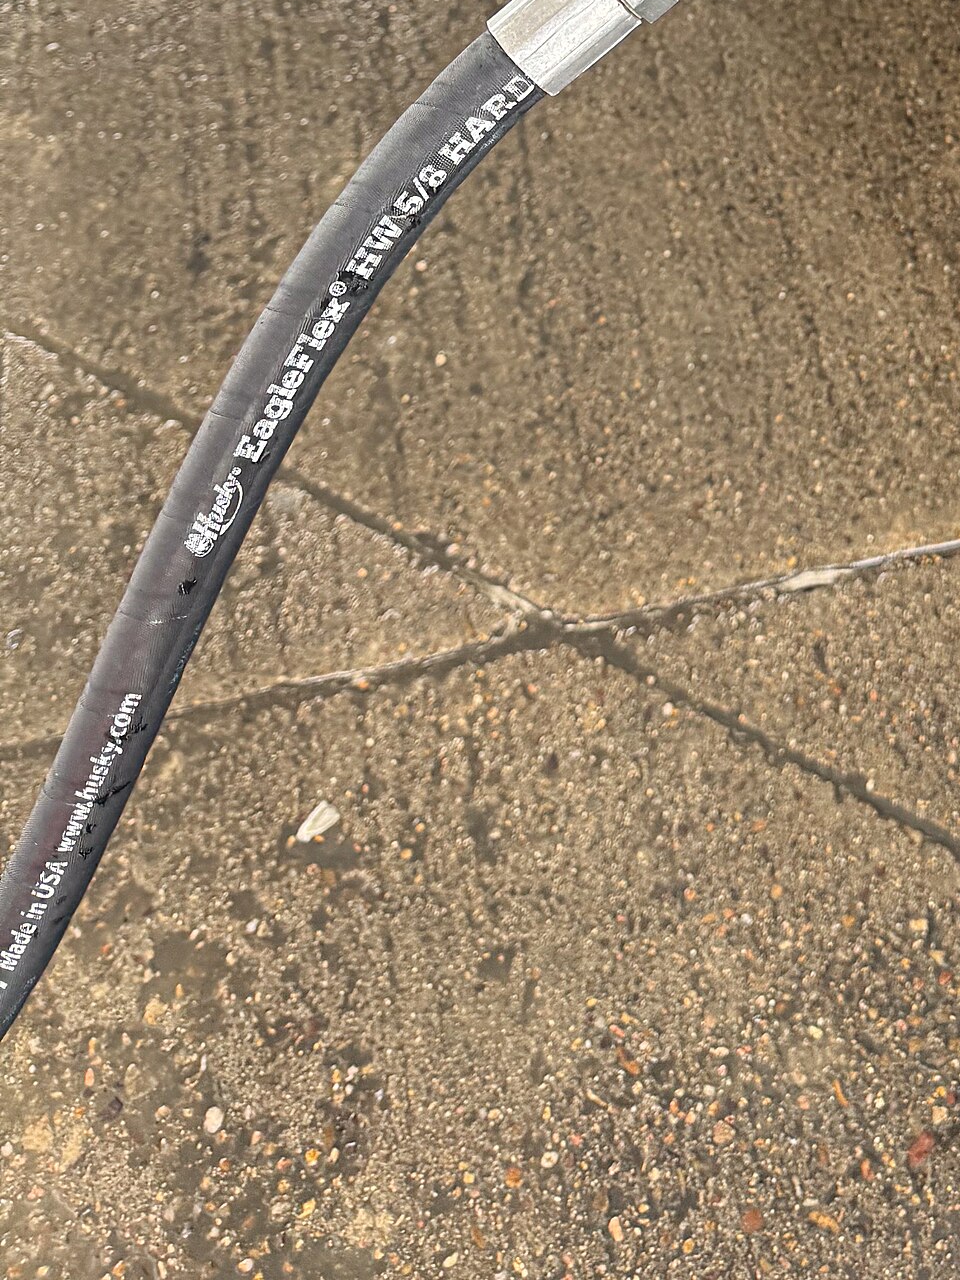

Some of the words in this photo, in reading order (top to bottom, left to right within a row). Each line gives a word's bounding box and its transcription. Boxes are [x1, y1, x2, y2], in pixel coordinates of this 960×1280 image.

[347, 215, 403, 281] HW
[393, 166, 447, 220] 5/8
[438, 74, 536, 166] HARD
[58, 692, 142, 854] www.husky.com
[31, 860, 69, 901] USA
[20, 902, 48, 920] in
[0, 923, 38, 972] Made
